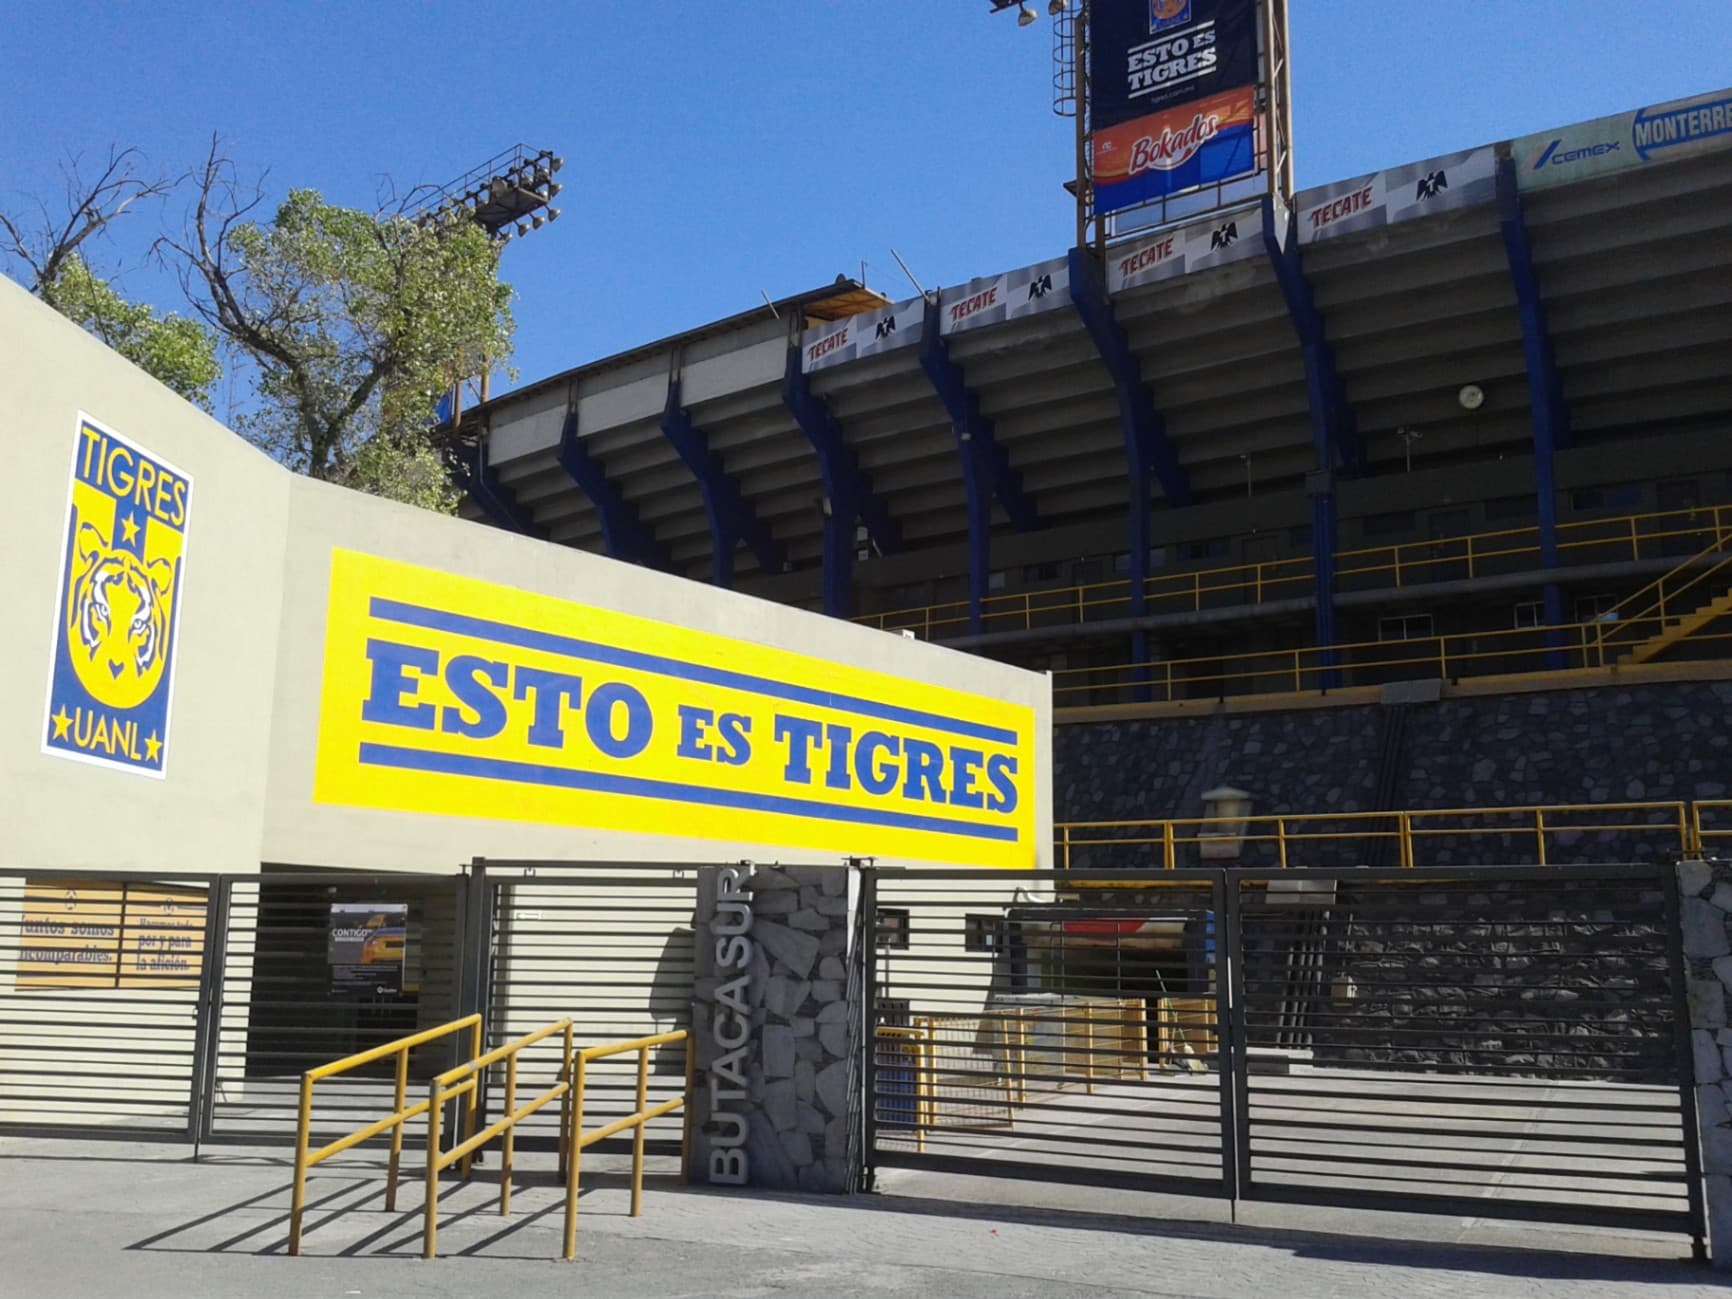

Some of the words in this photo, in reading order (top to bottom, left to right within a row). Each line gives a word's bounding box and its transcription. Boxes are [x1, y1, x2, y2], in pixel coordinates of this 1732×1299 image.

[1128, 38, 1190, 71] ESTO
[1193, 30, 1216, 49] ES
[1128, 47, 1217, 91] TIGRES
[1130, 114, 1219, 174] Bokados
[1552, 140, 1620, 165] CEMEX
[1311, 186, 1373, 228] TECATE
[1120, 238, 1174, 278] TECATE
[951, 286, 997, 321] TECATE
[809, 328, 848, 362] TECATE
[81, 426, 187, 527] TIGRES
[74, 706, 142, 761] UANL
[362, 637, 654, 759] ESTO
[677, 703, 752, 766] ES
[774, 713, 1018, 814] TIGRES
[332, 927, 368, 937] CONTIGO
[715, 867, 754, 969] SUR
[709, 974, 750, 1185] BUTACA
